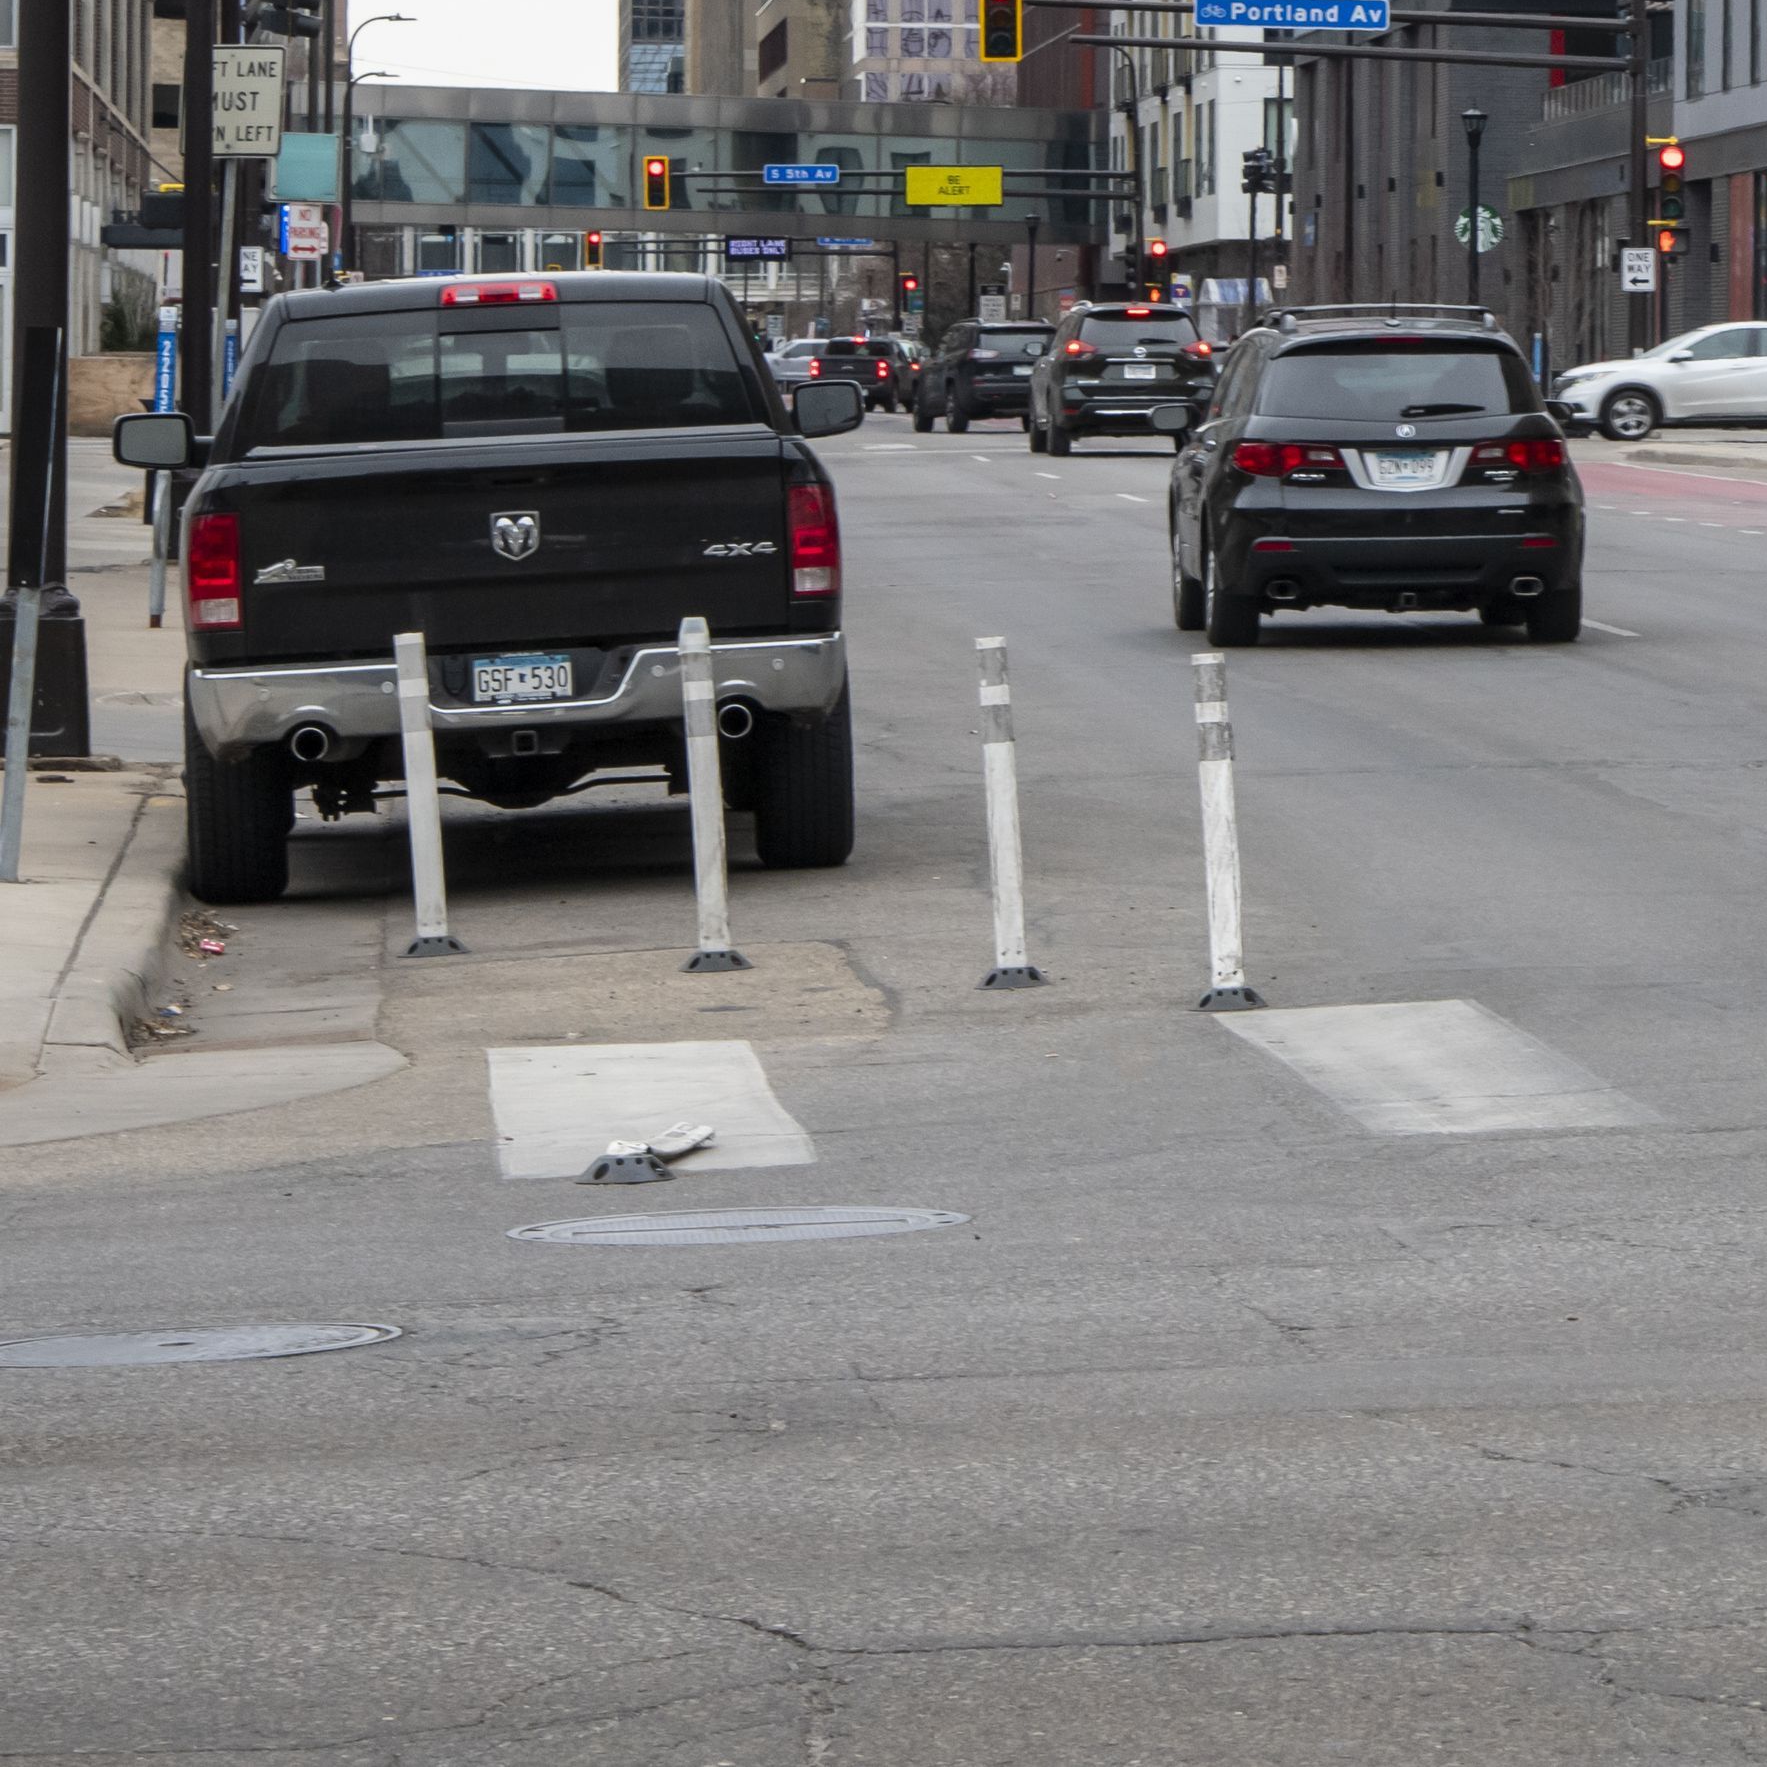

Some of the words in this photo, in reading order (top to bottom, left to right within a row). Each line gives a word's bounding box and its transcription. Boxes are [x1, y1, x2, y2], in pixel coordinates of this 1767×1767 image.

[1230, 2, 1339, 23] Portland
[1350, 5, 1382, 23] Av
[236, 61, 277, 77] LANE
[236, 126, 274, 141] LEFT
[815, 169, 832, 178] Av
[947, 175, 960, 184] BE
[938, 186, 970, 195] ALERT
[243, 252, 258, 262] NE
[1628, 252, 1650, 262] ONE
[243, 264, 259, 273] AY
[1628, 265, 1651, 273] WAY
[478, 668, 514, 693] GSF
[531, 665, 568, 690] 530
